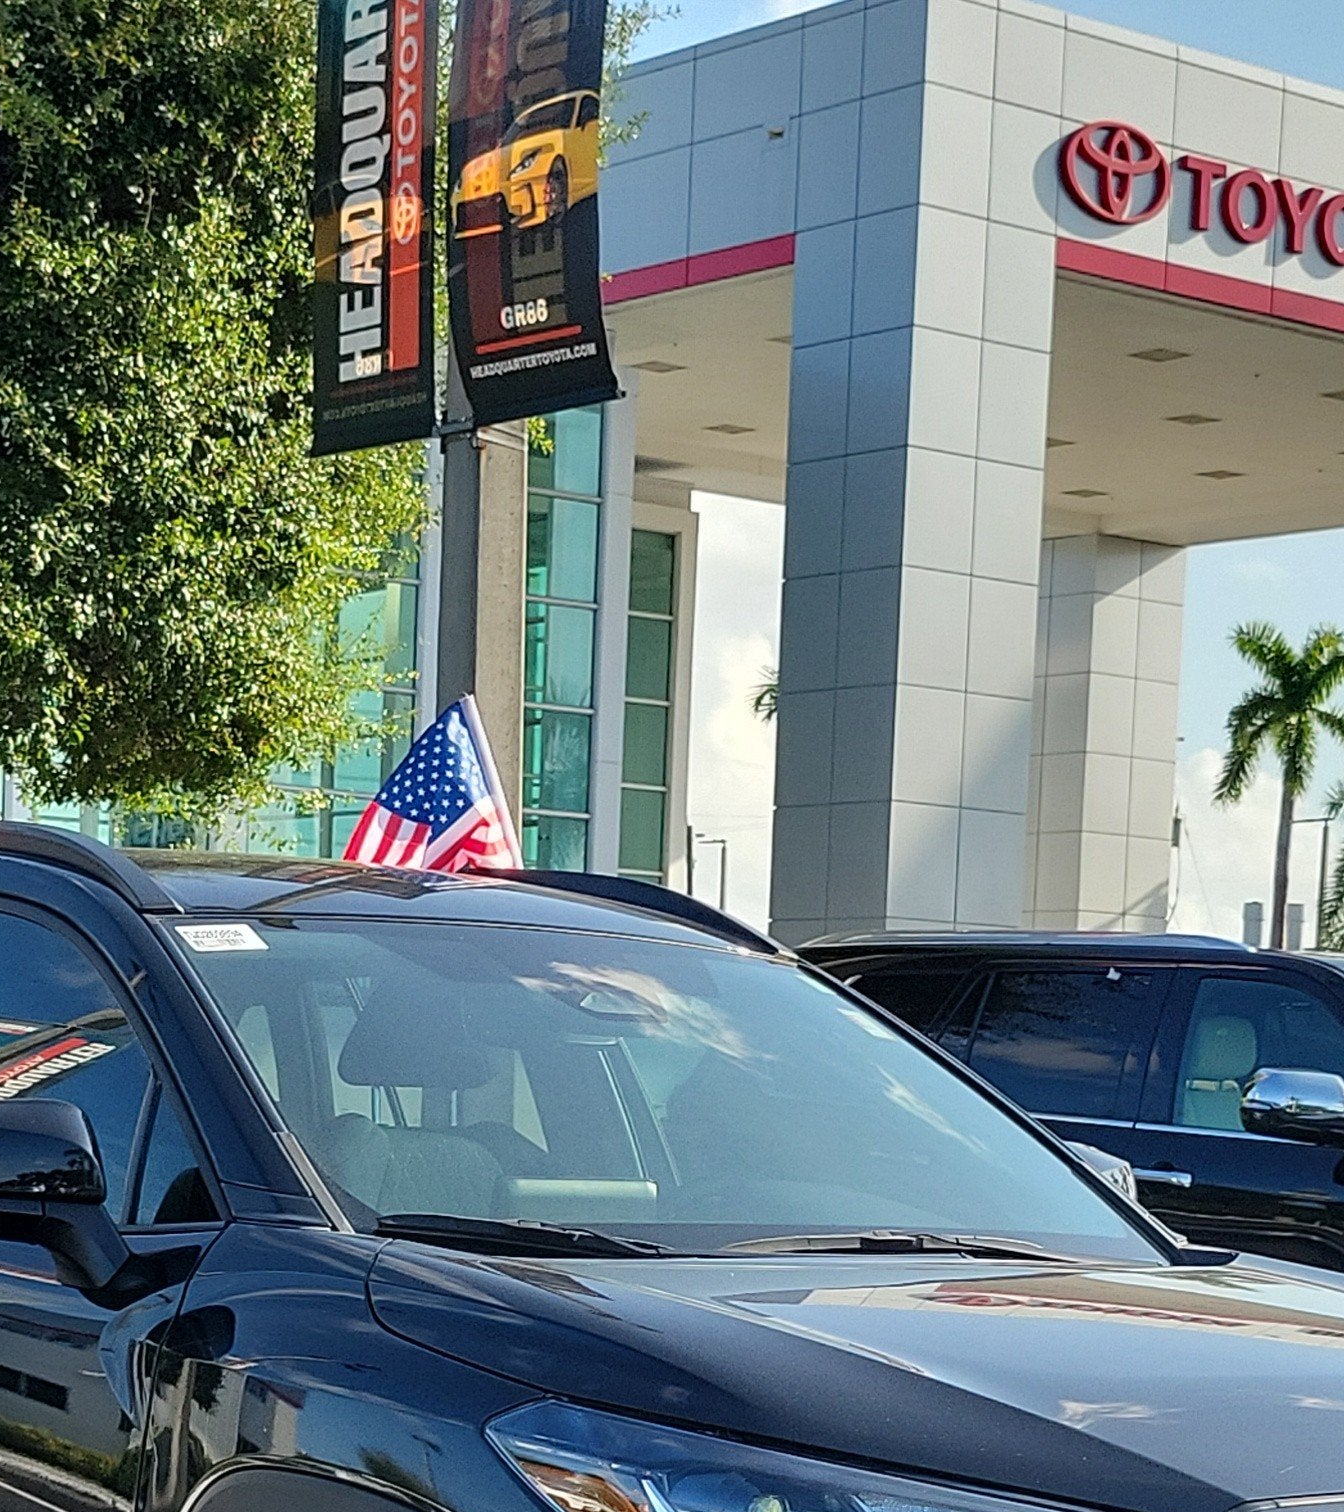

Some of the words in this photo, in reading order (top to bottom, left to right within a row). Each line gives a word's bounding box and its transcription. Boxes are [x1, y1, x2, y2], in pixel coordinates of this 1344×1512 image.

[396, 0, 420, 178] TOYOT
[499, 298, 549, 330] GR86
[469, 343, 597, 379] HEADQUARTERTOYOTA.COM
